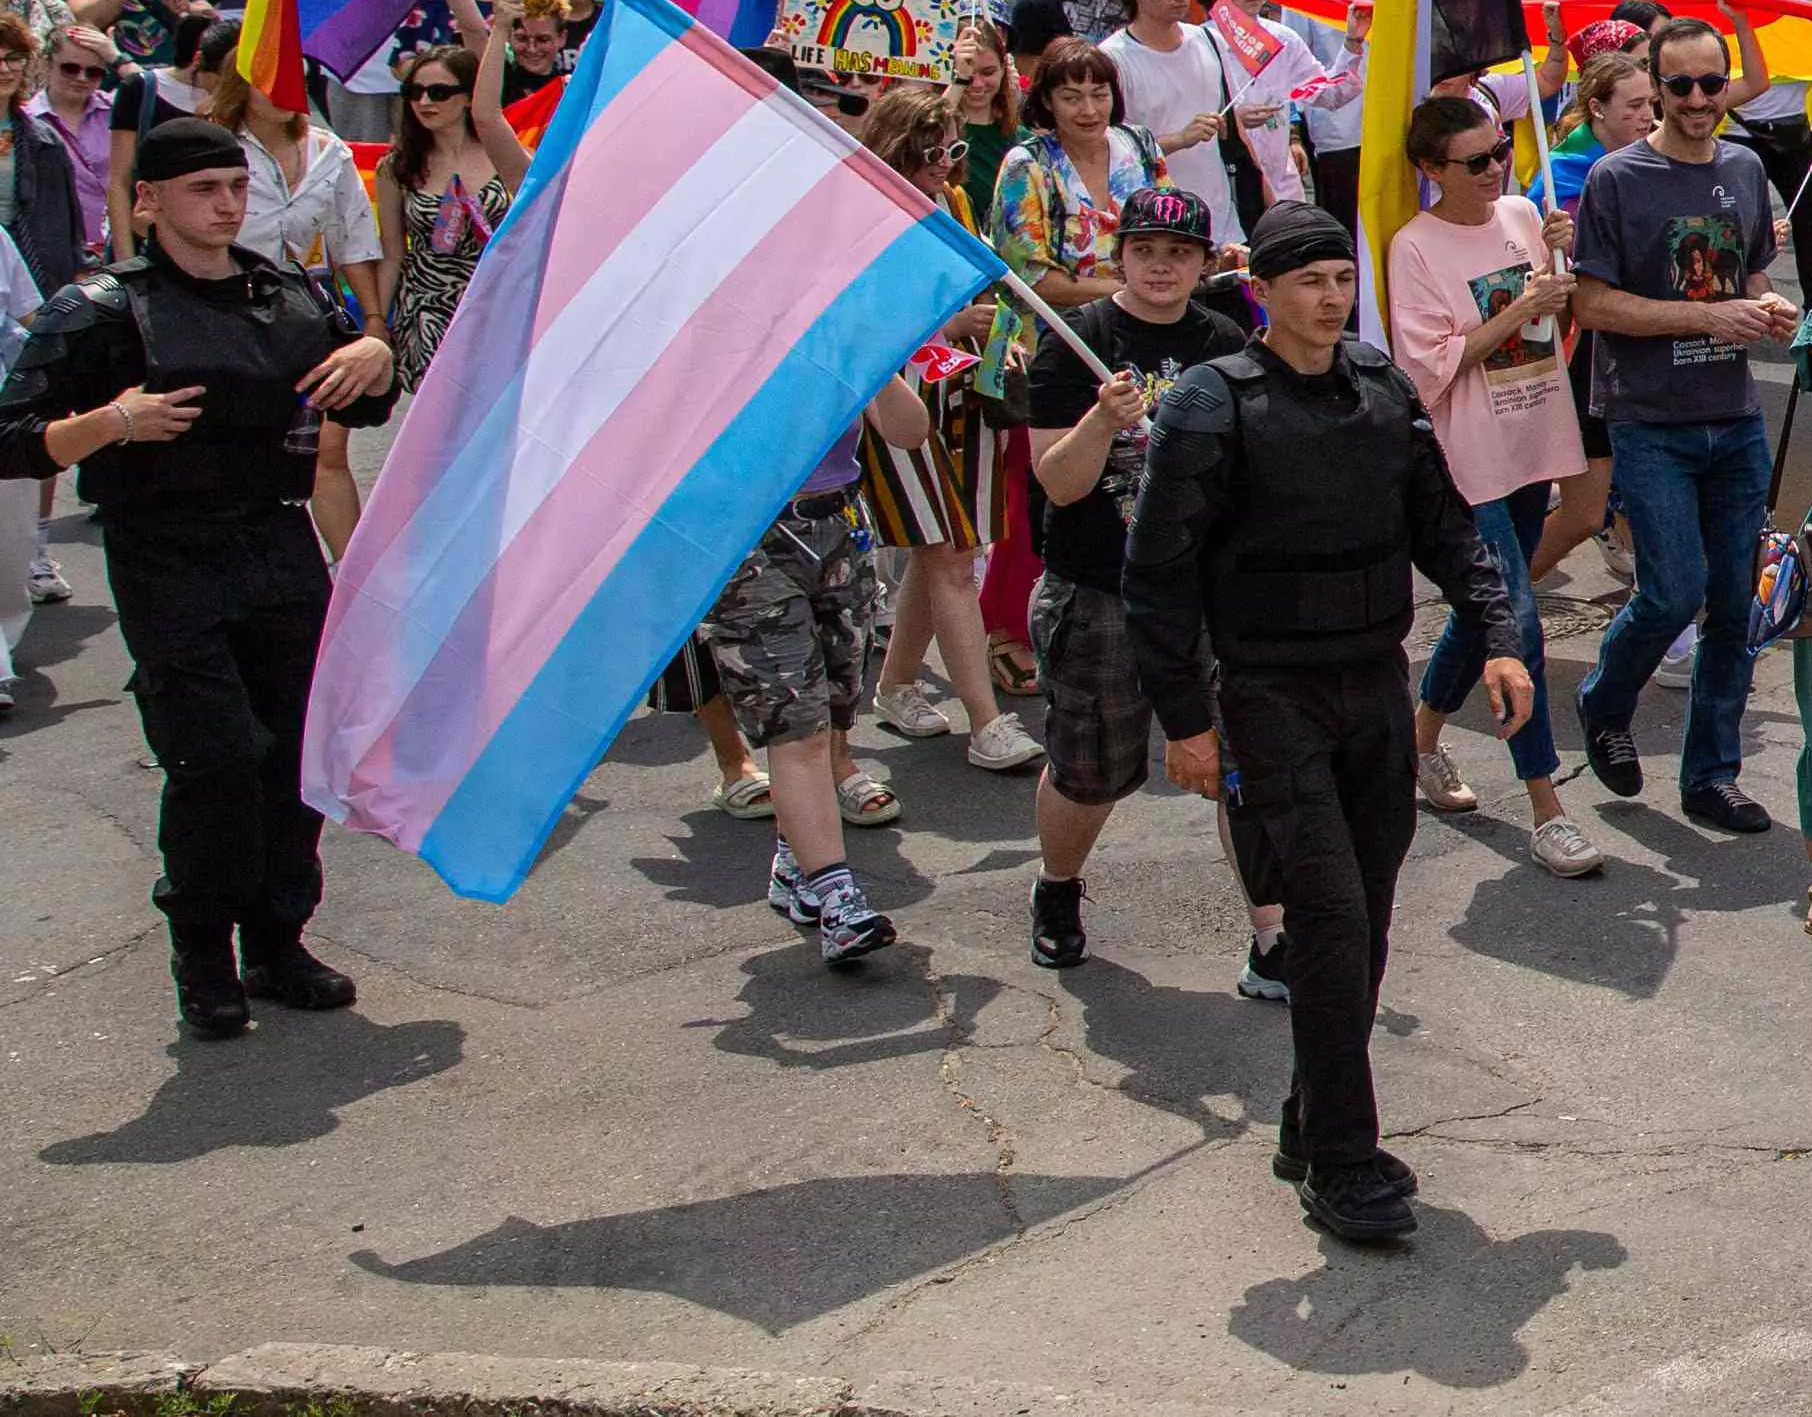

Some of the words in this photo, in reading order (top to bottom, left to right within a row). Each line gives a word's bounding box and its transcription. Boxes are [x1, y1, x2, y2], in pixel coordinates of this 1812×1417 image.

[792, 45, 825, 64] LIFE
[833, 47, 872, 72] HAS
[873, 55, 941, 80] MEANING
